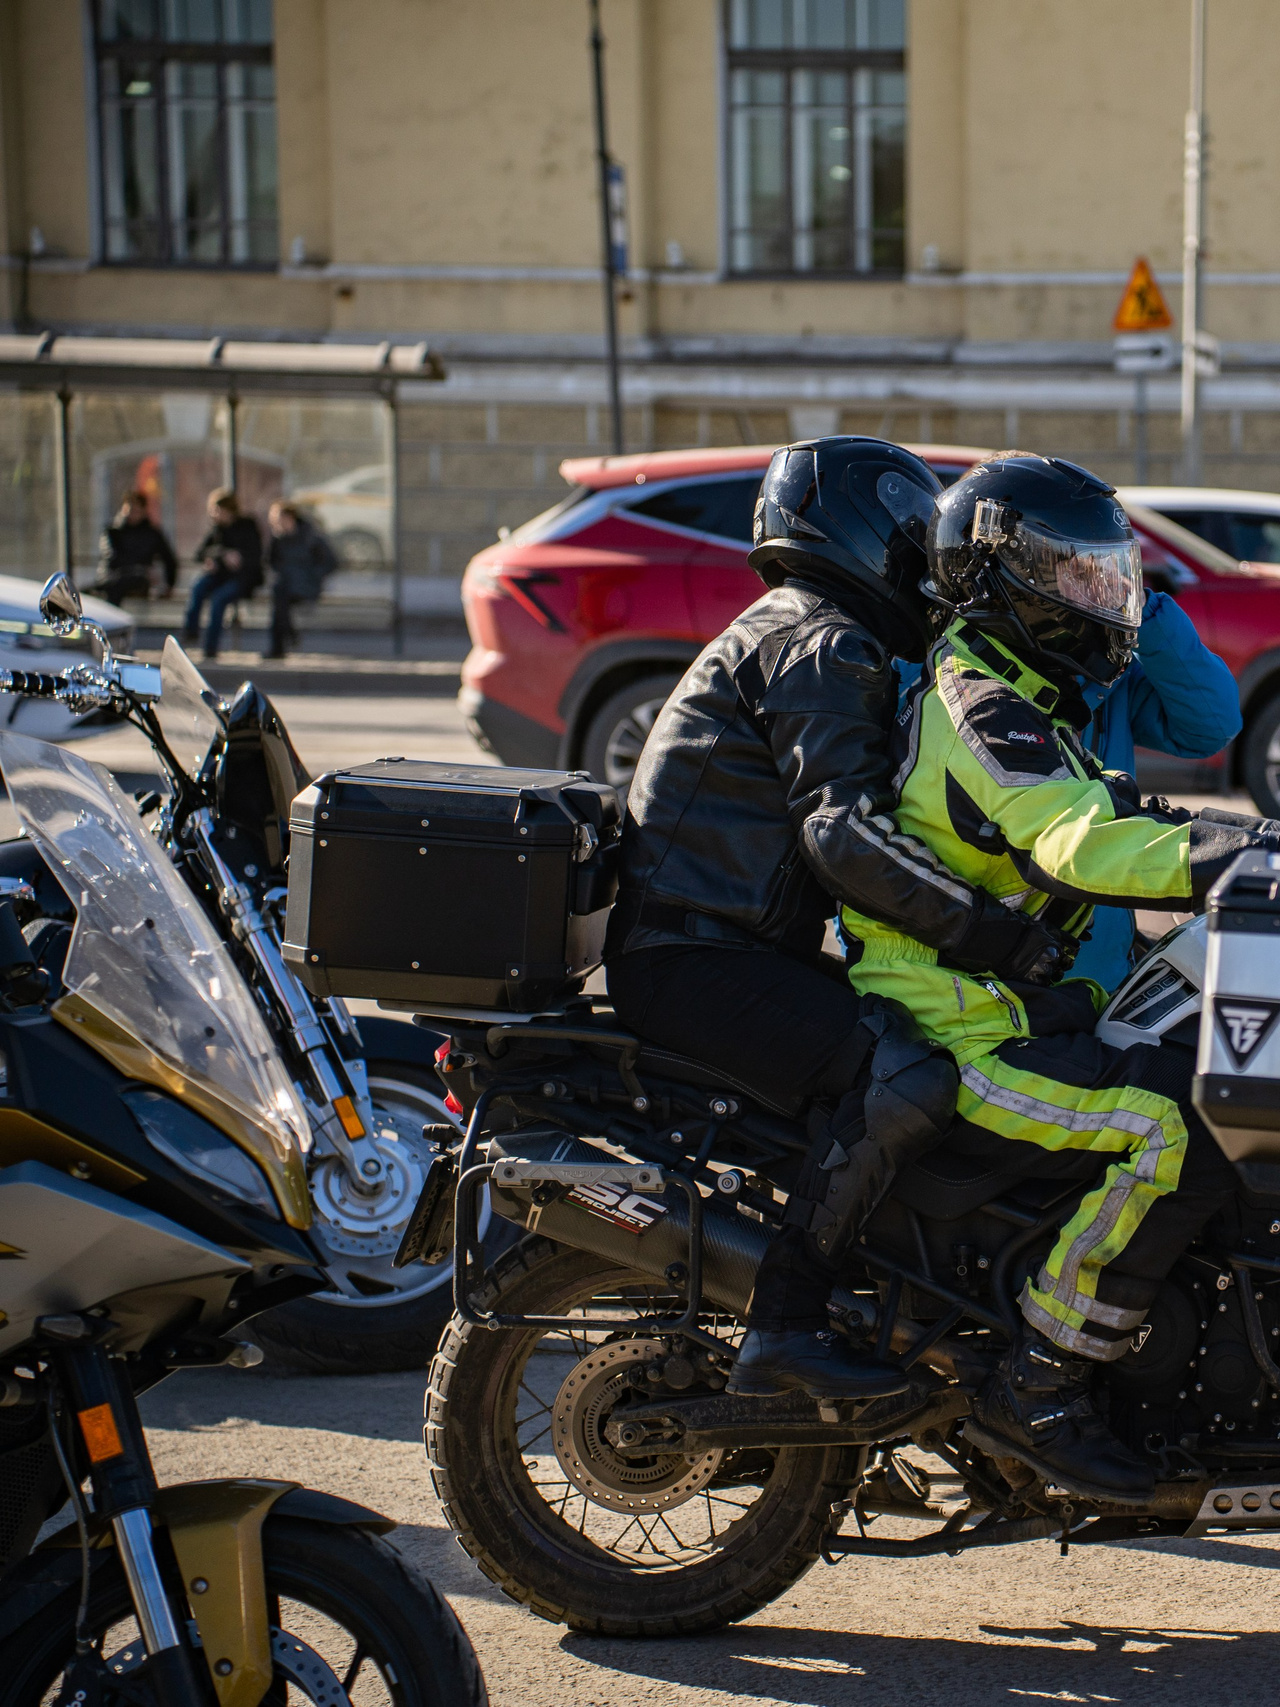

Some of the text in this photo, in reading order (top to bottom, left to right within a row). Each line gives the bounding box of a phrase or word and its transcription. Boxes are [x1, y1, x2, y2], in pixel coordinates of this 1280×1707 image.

[1007, 730, 1038, 743] Restyle
[1129, 973, 1180, 1008] 800
[562, 1169, 593, 1179] TRIUMPH
[567, 1190, 650, 1229] PROJECT
